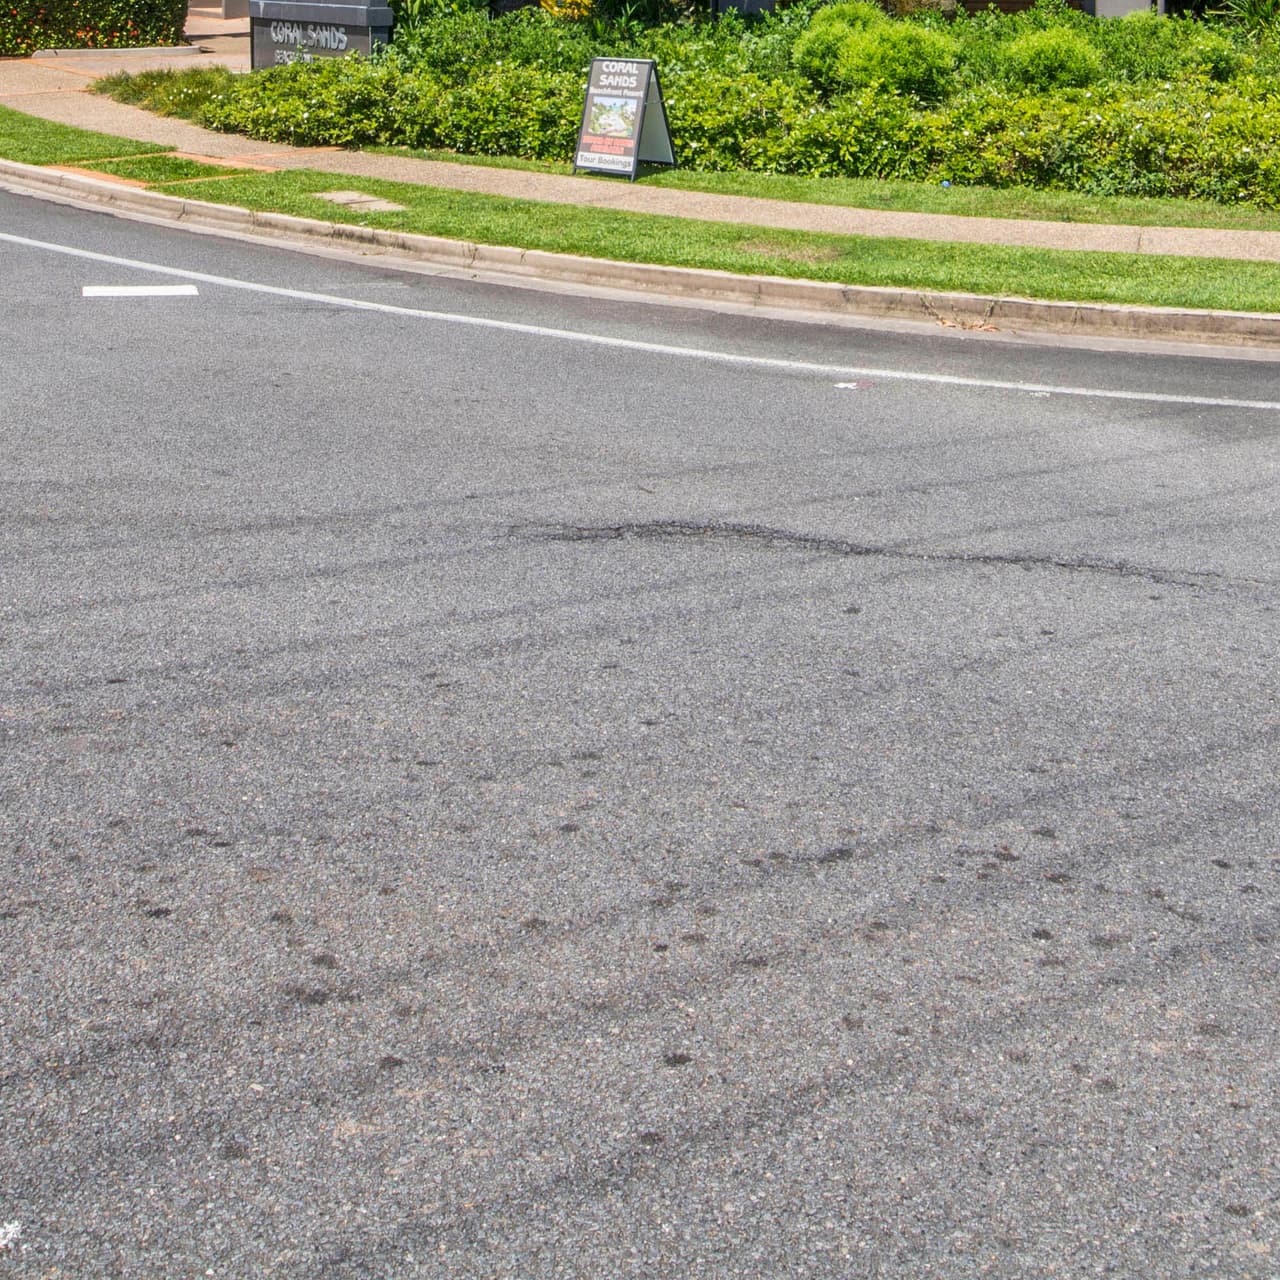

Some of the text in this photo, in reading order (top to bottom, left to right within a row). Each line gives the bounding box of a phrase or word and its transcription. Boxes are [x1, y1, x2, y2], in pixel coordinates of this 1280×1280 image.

[270, 21, 348, 50] CORAL SANDS
[602, 61, 639, 74] CORAL
[599, 75, 637, 88] SANDS
[580, 154, 632, 169] Tour Bookings
